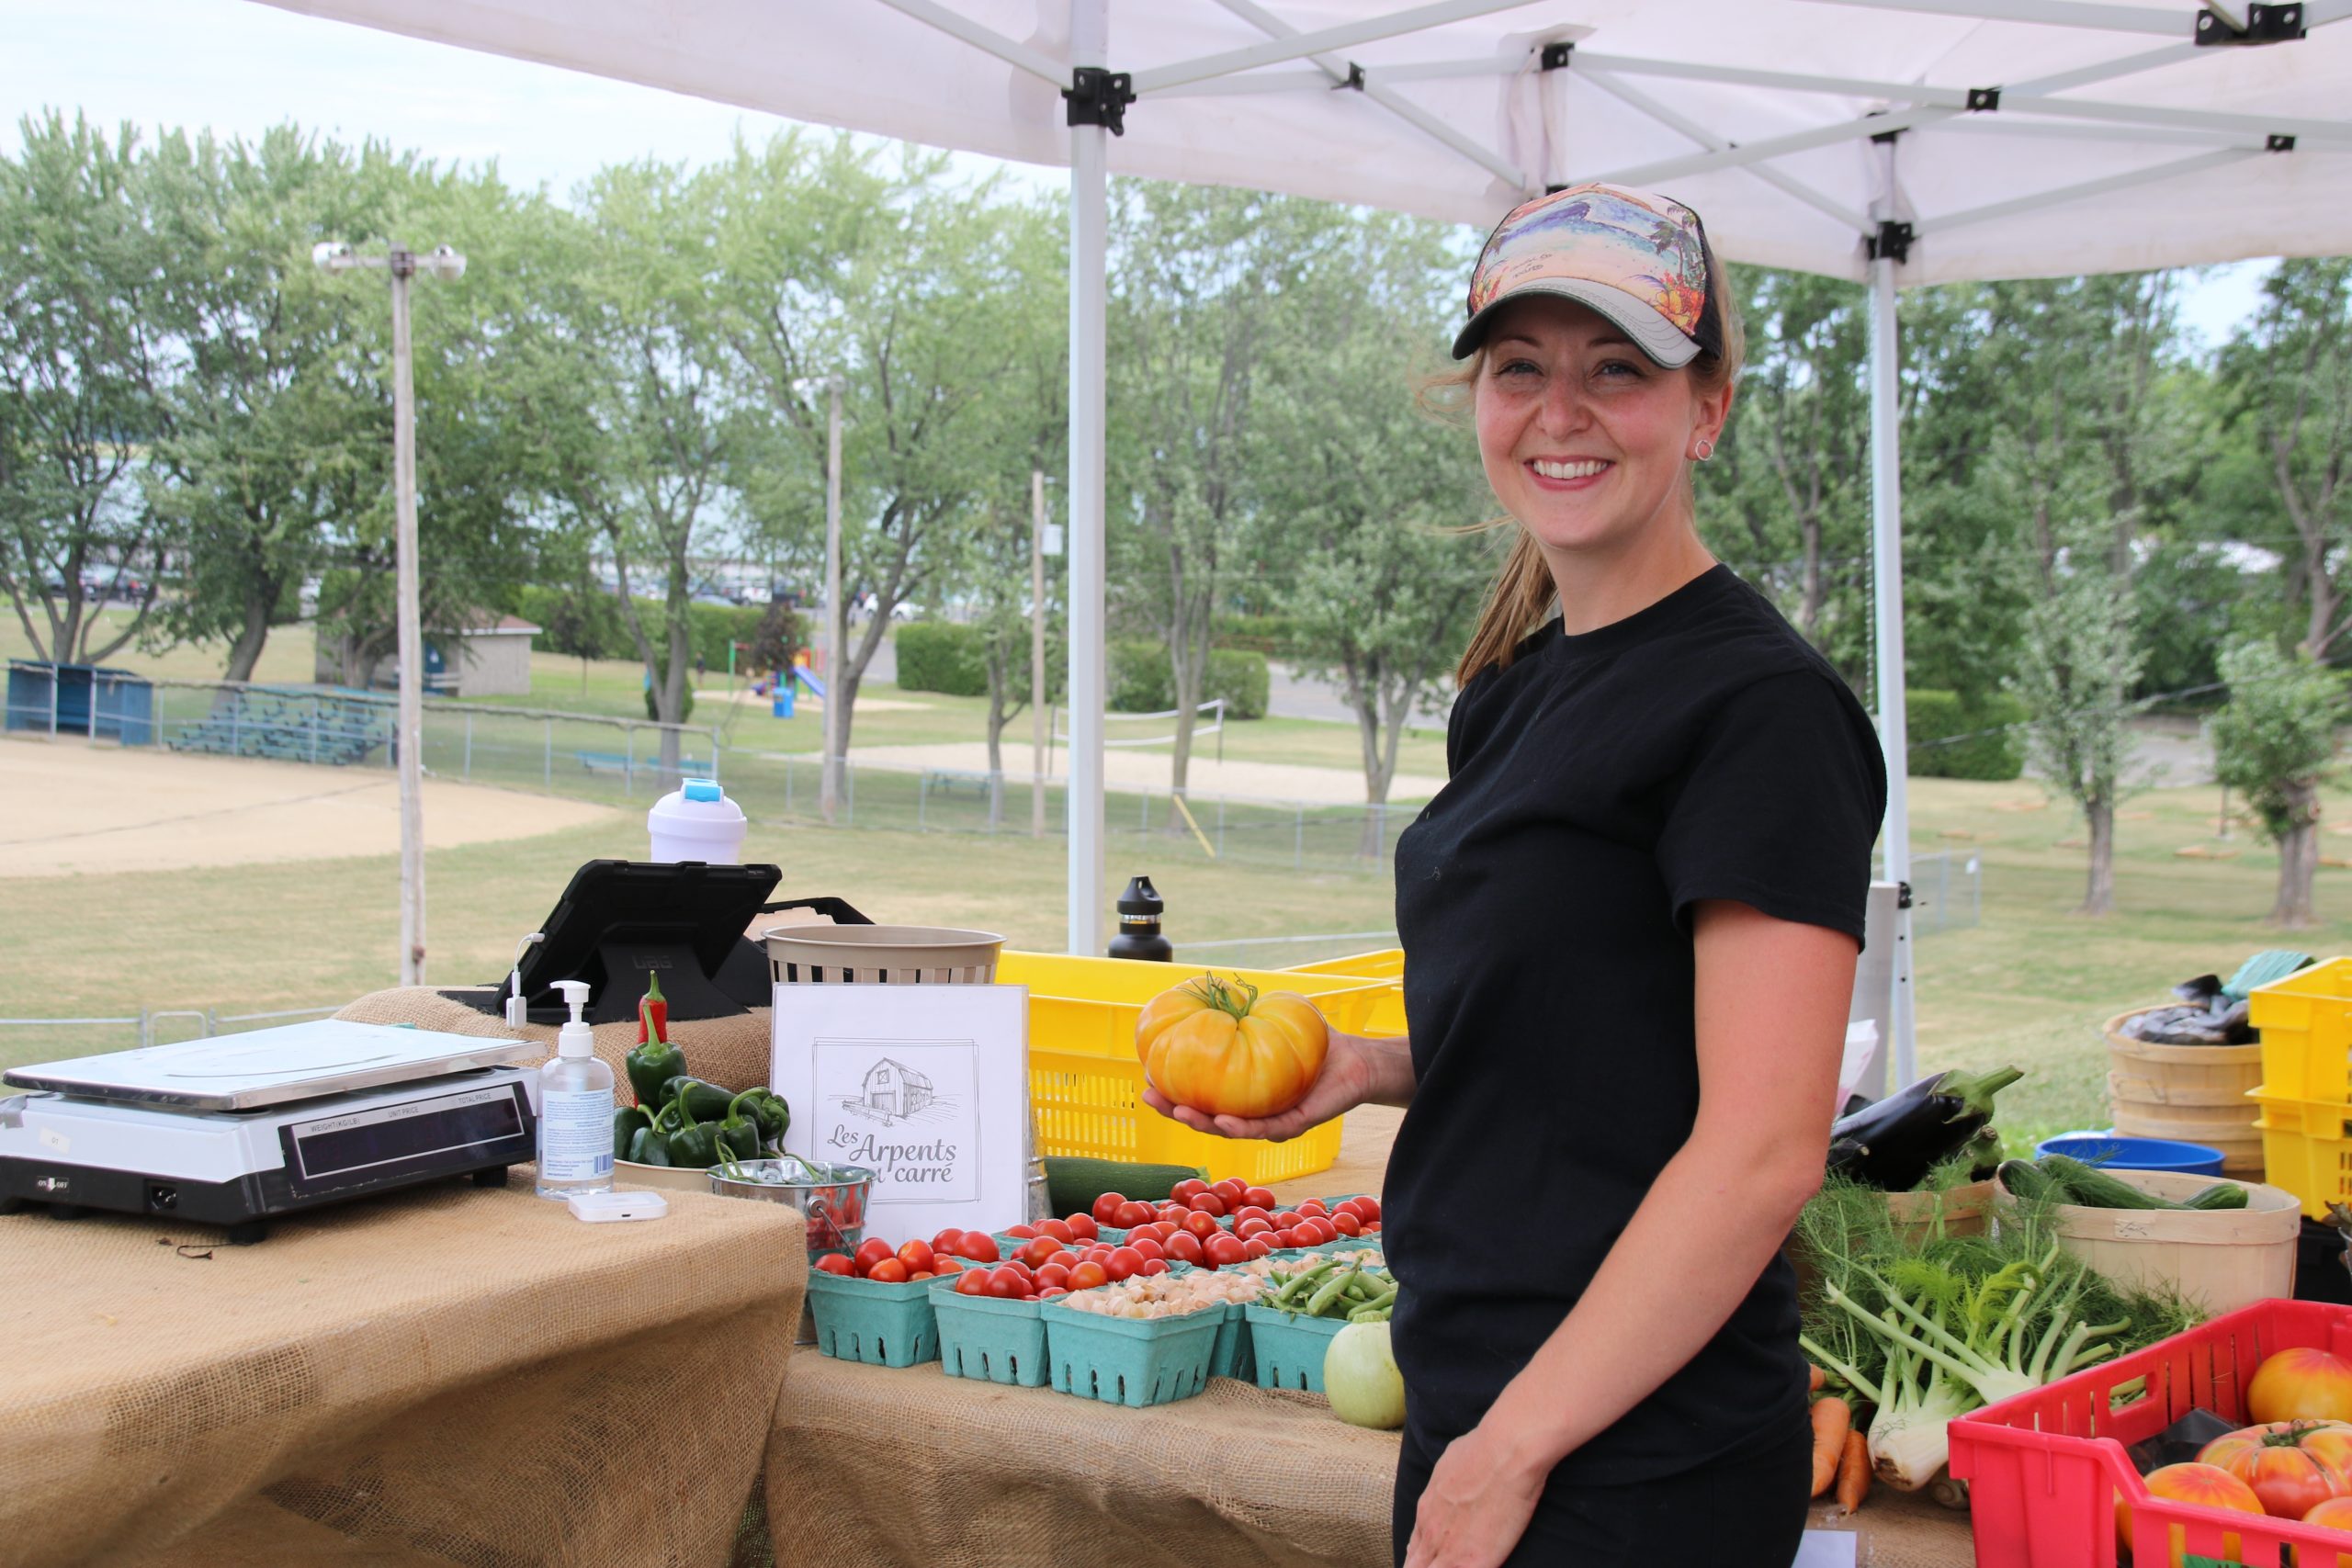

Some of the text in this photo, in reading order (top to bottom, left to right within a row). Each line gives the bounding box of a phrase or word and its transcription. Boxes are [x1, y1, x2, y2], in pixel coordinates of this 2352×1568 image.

[458, 1093, 492, 1104] TOTAL PRICE
[388, 1106, 419, 1118] UNIT PRICE
[827, 1123, 859, 1148] Les
[848, 1134, 957, 1173] Arpents
[894, 1162, 955, 1183] carré
